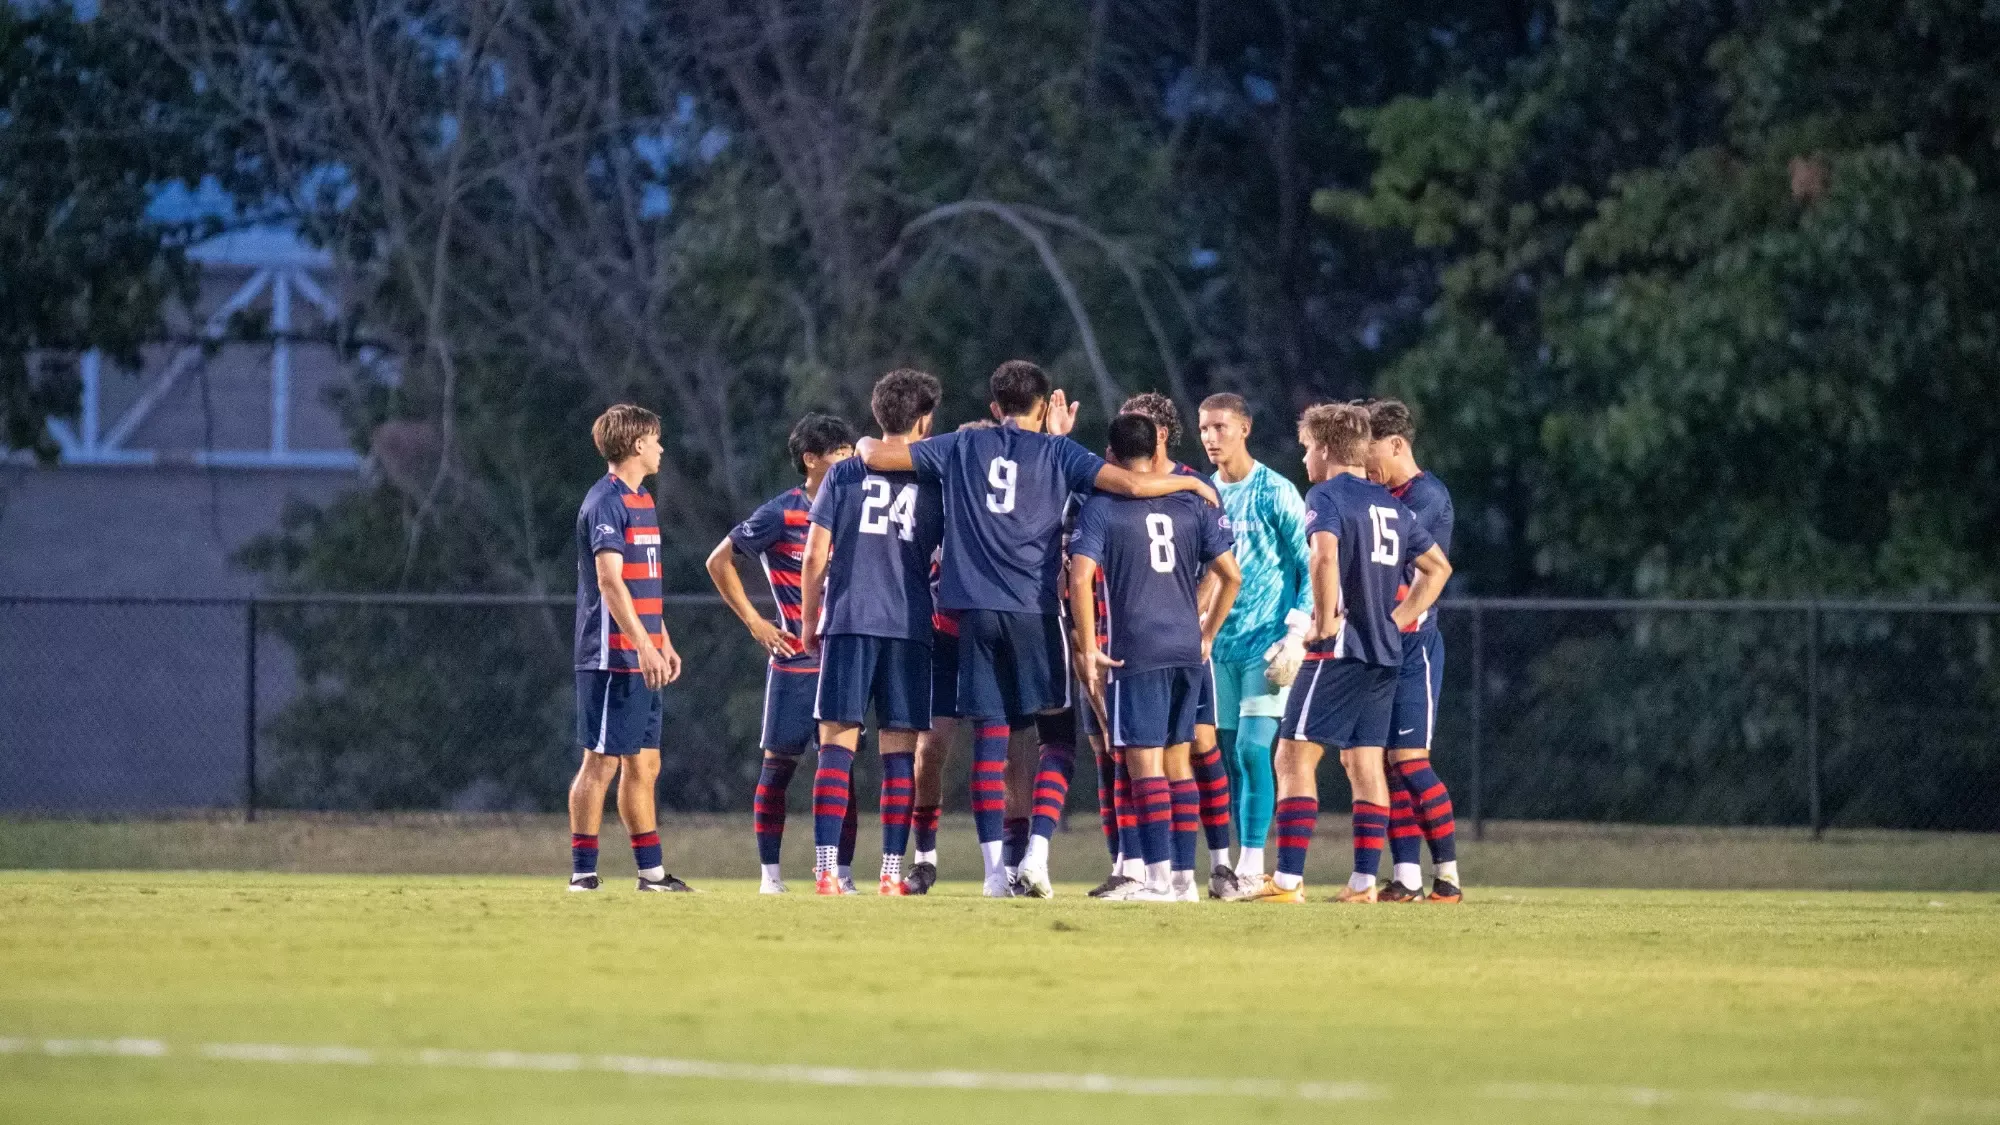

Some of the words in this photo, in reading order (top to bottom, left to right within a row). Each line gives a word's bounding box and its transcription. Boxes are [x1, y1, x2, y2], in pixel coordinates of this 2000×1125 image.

[859, 474, 918, 542] 24
[986, 456, 1018, 514] 9
[647, 547, 658, 578] 17
[1145, 512, 1176, 573] 8
[1368, 503, 1400, 567] 15
